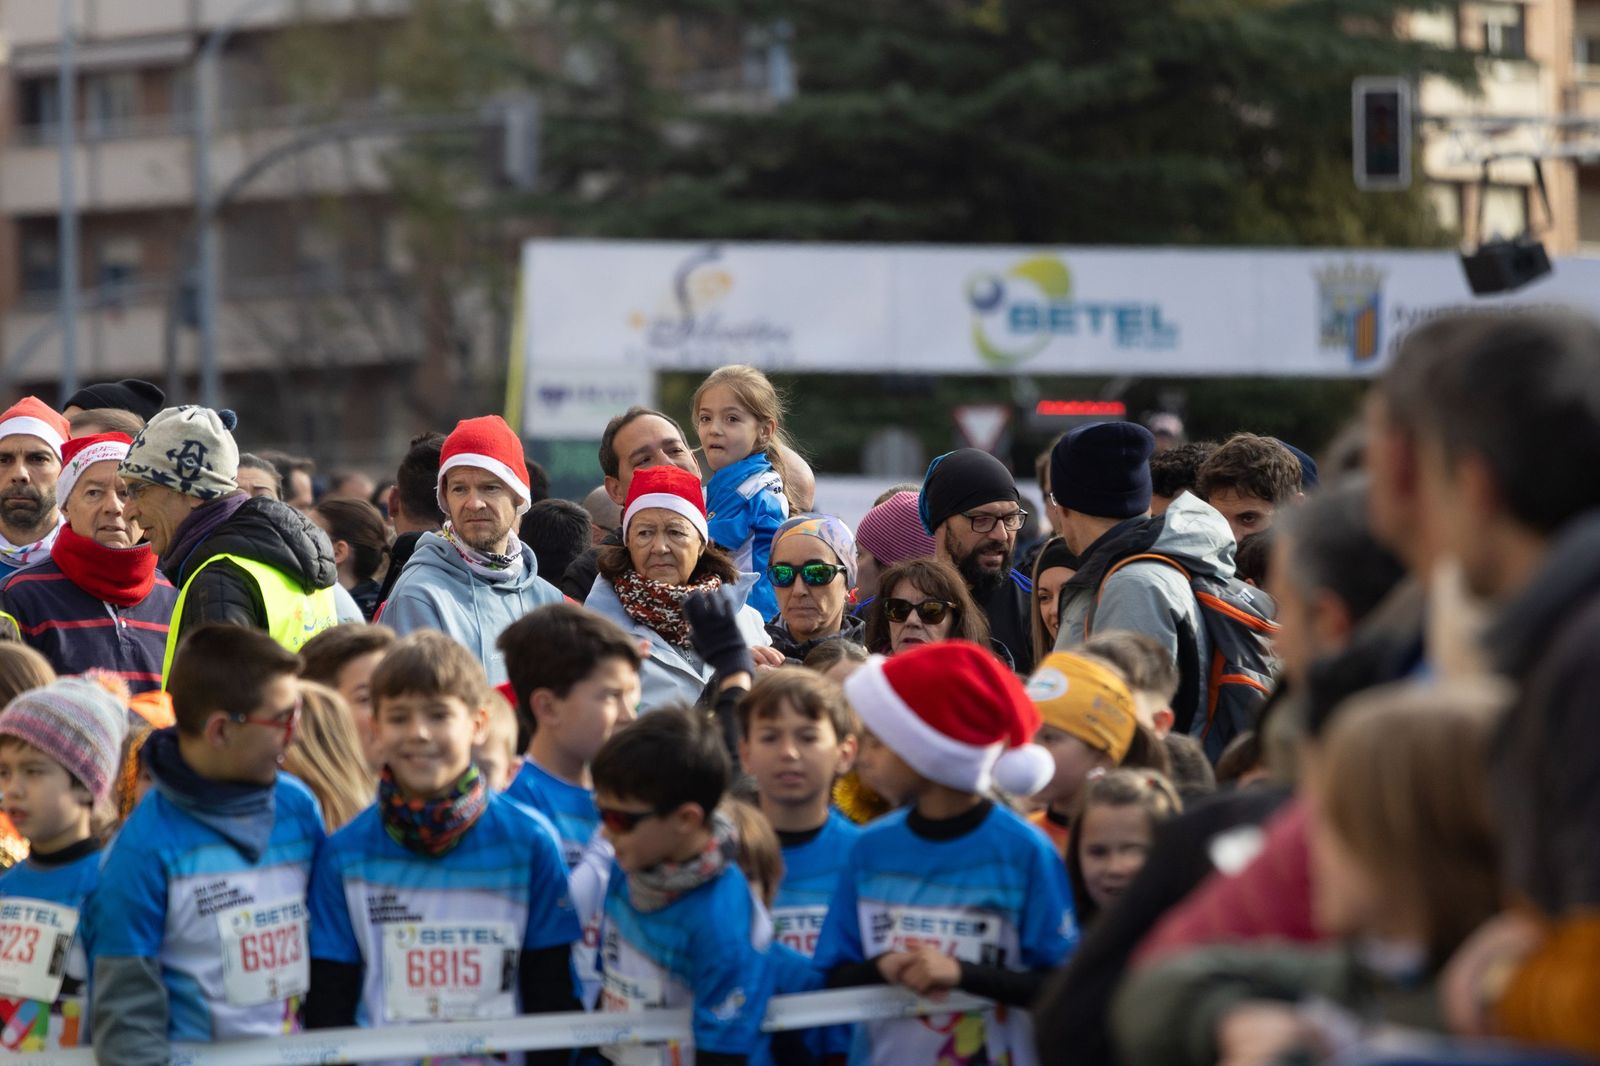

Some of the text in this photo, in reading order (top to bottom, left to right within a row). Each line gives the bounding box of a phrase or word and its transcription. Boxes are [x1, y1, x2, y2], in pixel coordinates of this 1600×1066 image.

[241, 923, 302, 973] 6923
[421, 928, 504, 945] BETEL
[407, 948, 482, 988] 6815
